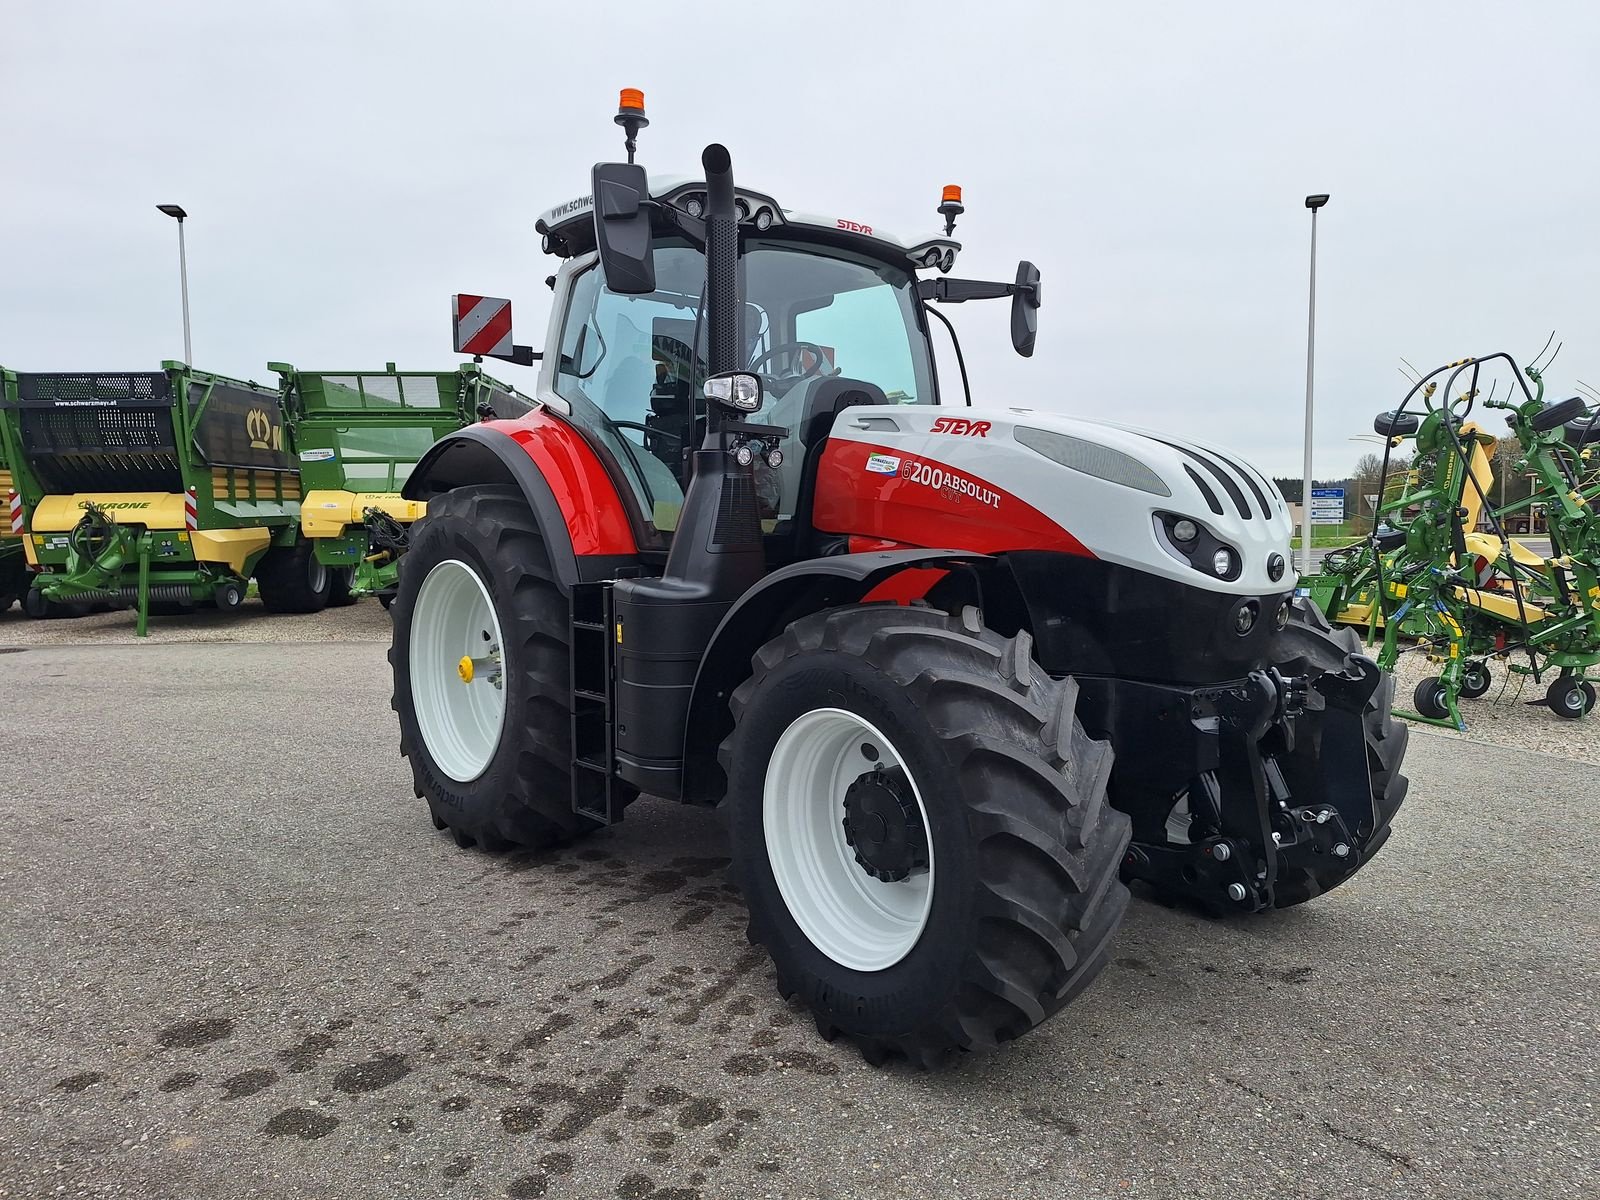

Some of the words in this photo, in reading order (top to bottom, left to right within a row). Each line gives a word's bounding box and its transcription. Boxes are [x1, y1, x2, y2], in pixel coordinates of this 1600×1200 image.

[837, 219, 872, 236] STEYR
[929, 417, 992, 438] STEYR
[1446, 450, 1455, 480] KRONE
[901, 460, 942, 490] 6200
[942, 472, 1001, 509] ABSOLUT
